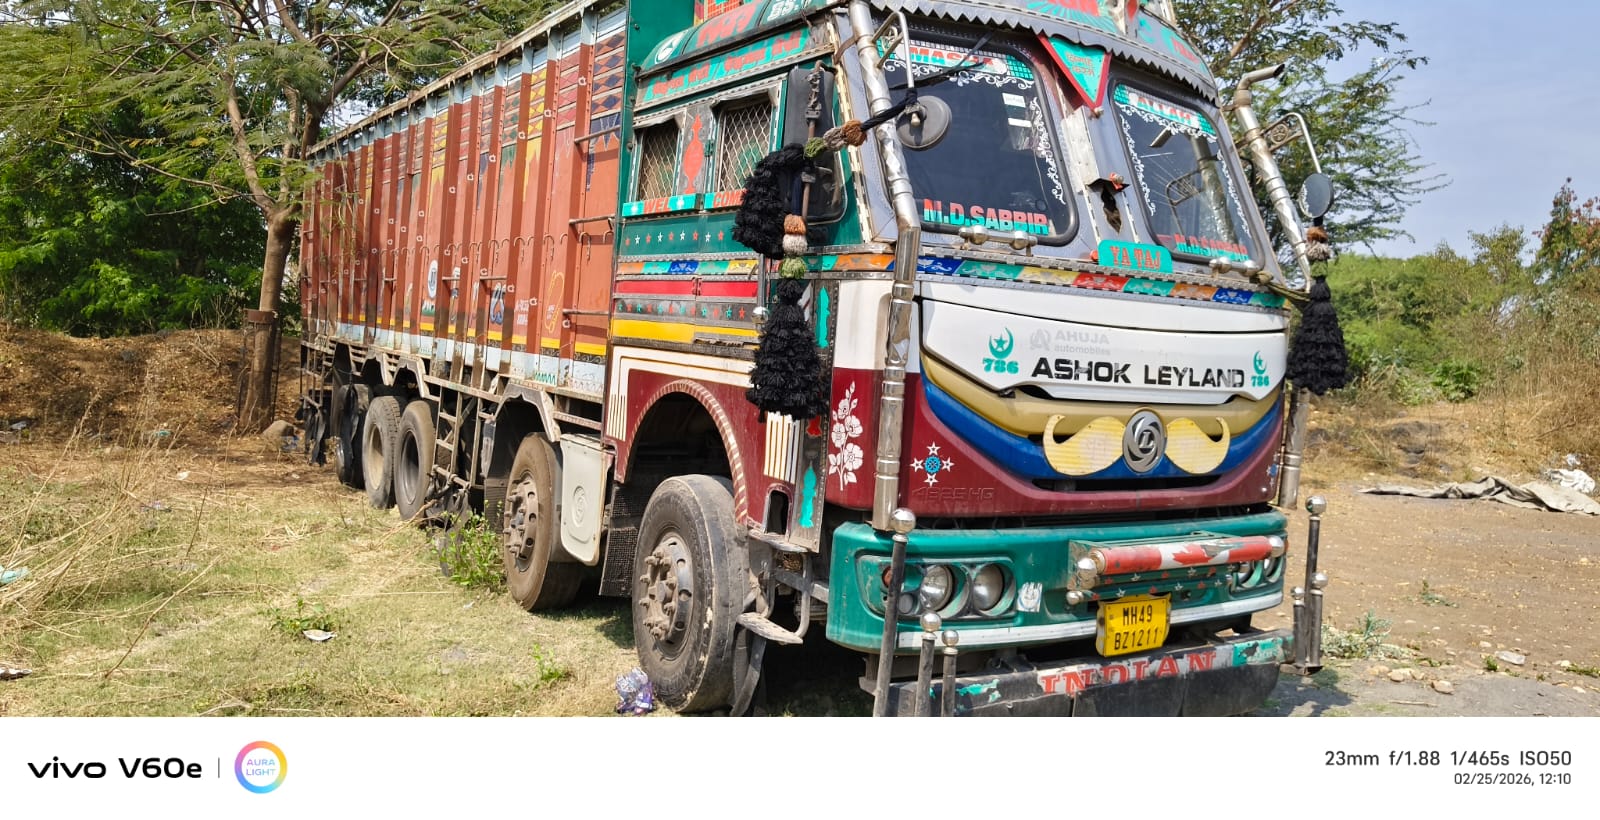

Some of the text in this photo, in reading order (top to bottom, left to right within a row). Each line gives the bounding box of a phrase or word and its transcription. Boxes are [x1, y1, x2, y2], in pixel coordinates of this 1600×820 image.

[643, 197, 671, 215] WEL
[923, 199, 1050, 236] M.D.SABBIR
[1110, 246, 1161, 270] YA TAJ
[1055, 329, 1110, 345] AHUJA
[982, 357, 1019, 374] 786
[1031, 356, 1245, 388] ASHOK LEYLAND
[1250, 375, 1270, 388] 786
[1122, 604, 1153, 626] MH49
[1114, 627, 1159, 650] BZ1211
[1040, 651, 1217, 696] INDIAN
